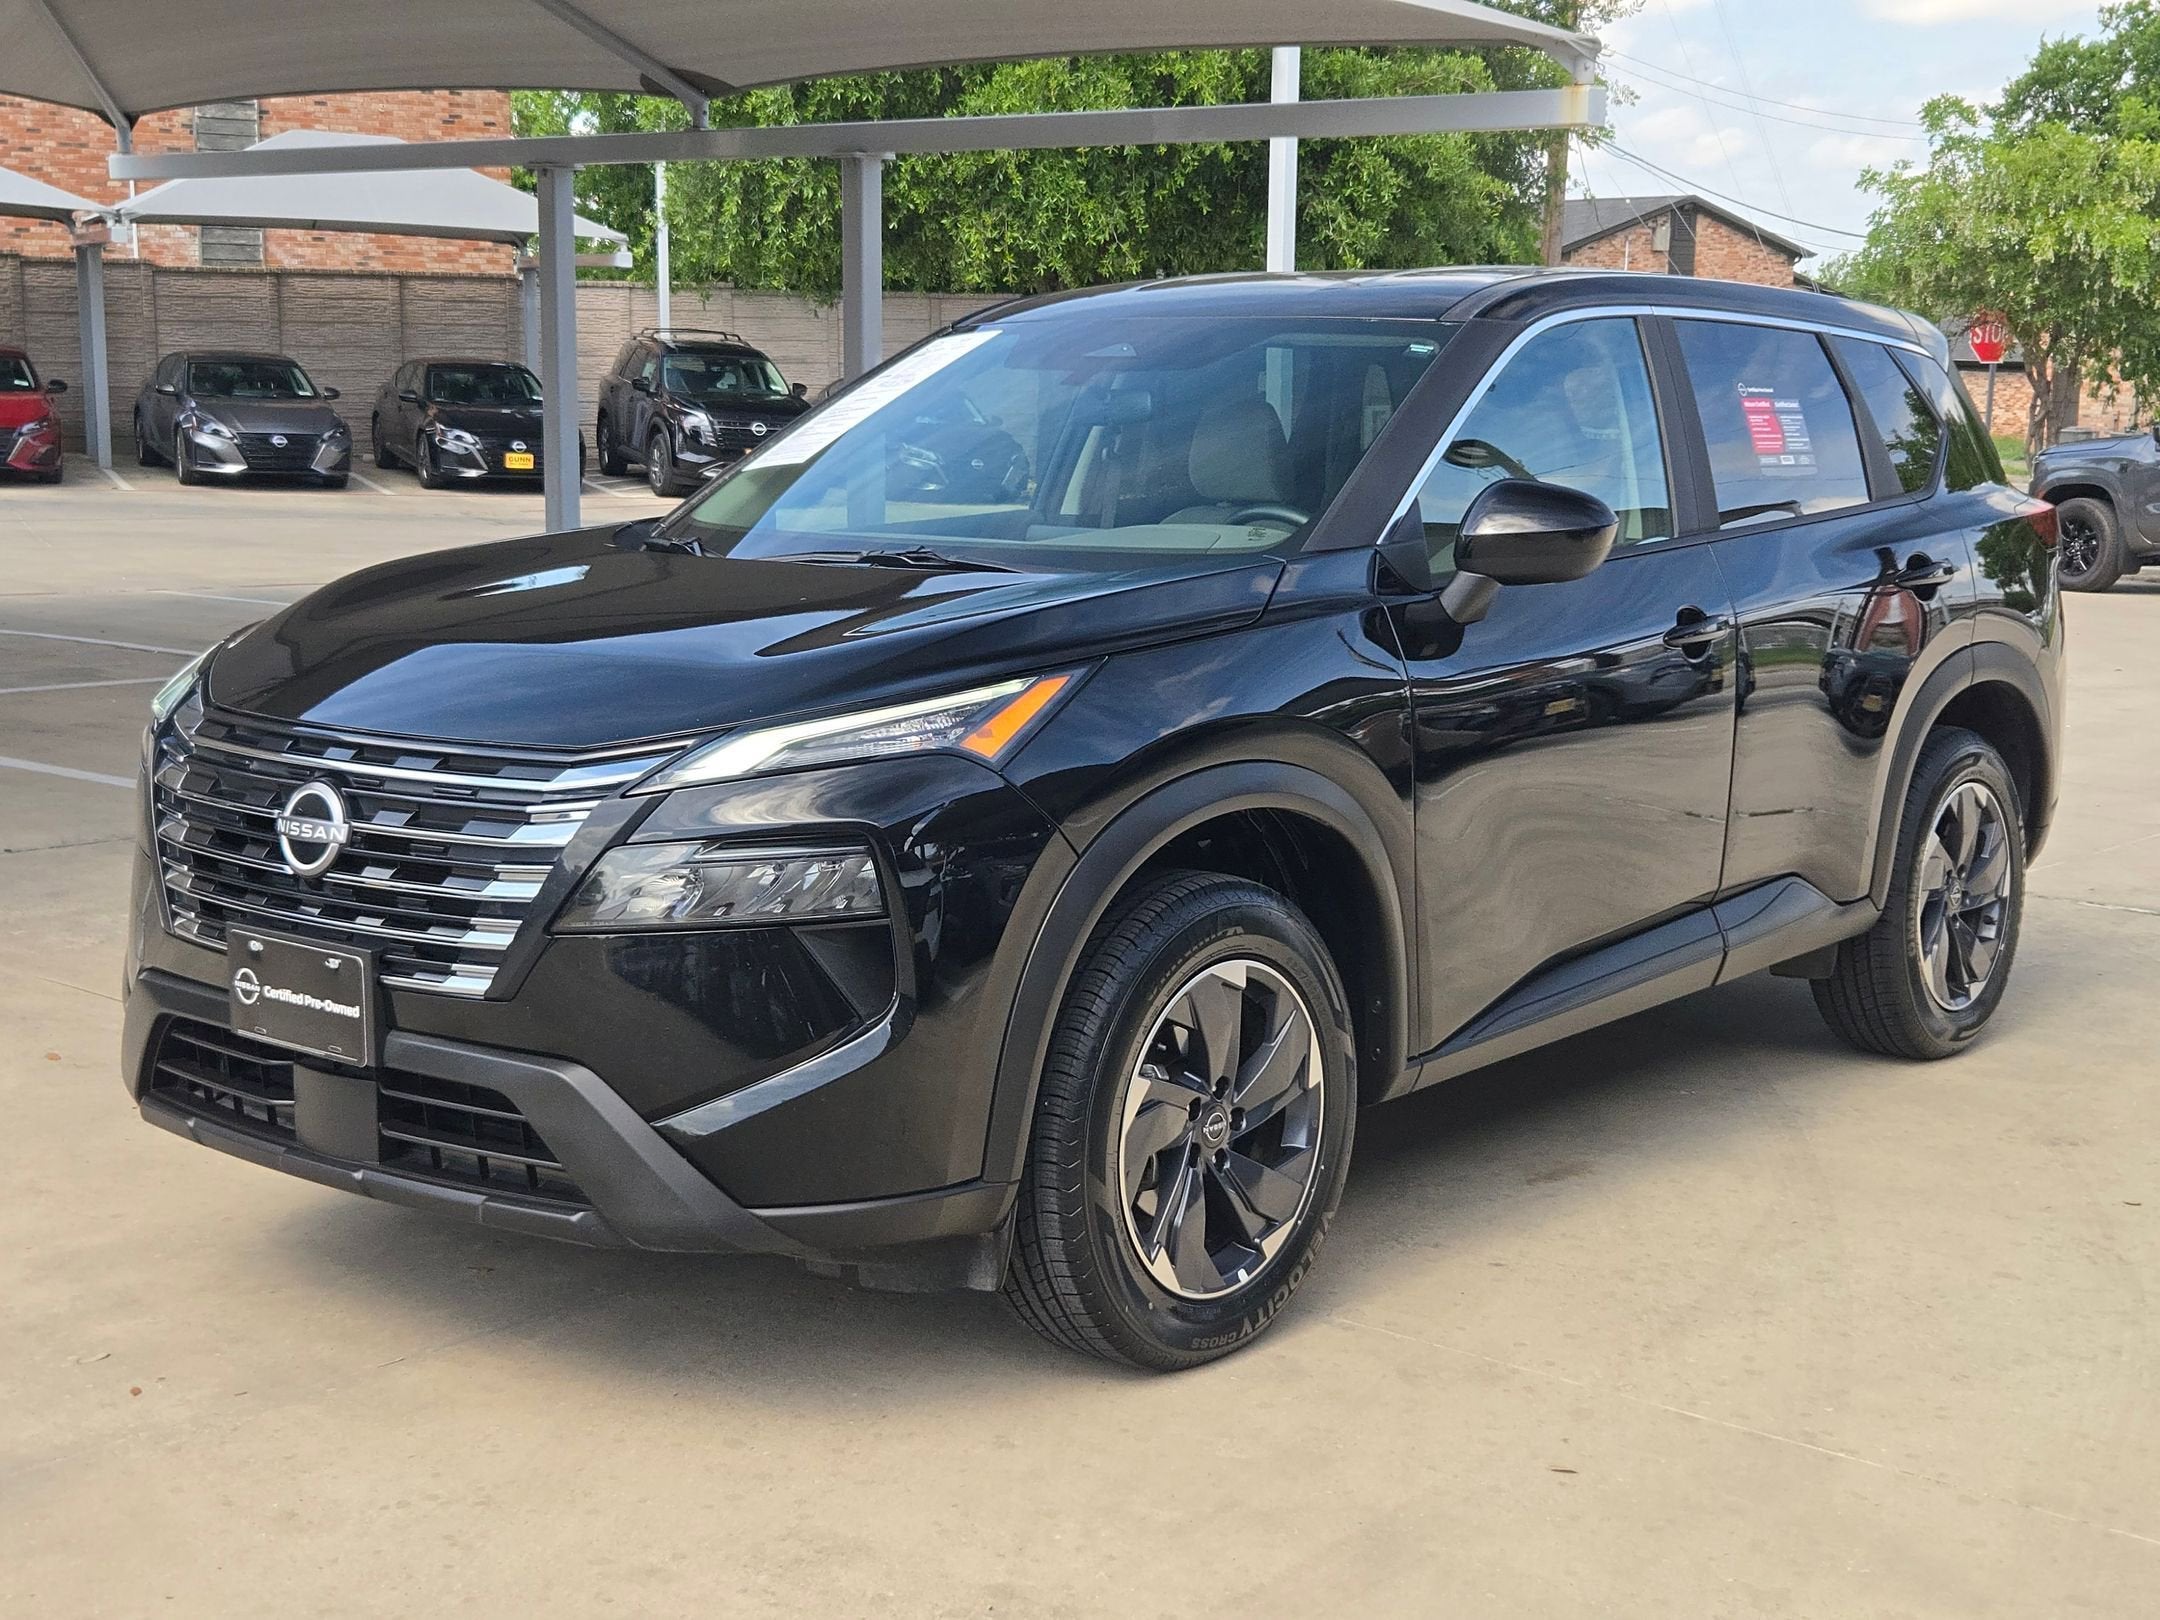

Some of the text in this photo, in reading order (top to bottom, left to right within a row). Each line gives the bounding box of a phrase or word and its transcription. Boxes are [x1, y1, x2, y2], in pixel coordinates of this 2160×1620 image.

[277, 818, 345, 842] NISSAN
[262, 985, 360, 1018] Certified Pre-Owned
[1191, 1211, 1335, 1349] VELOCITY CROSS
